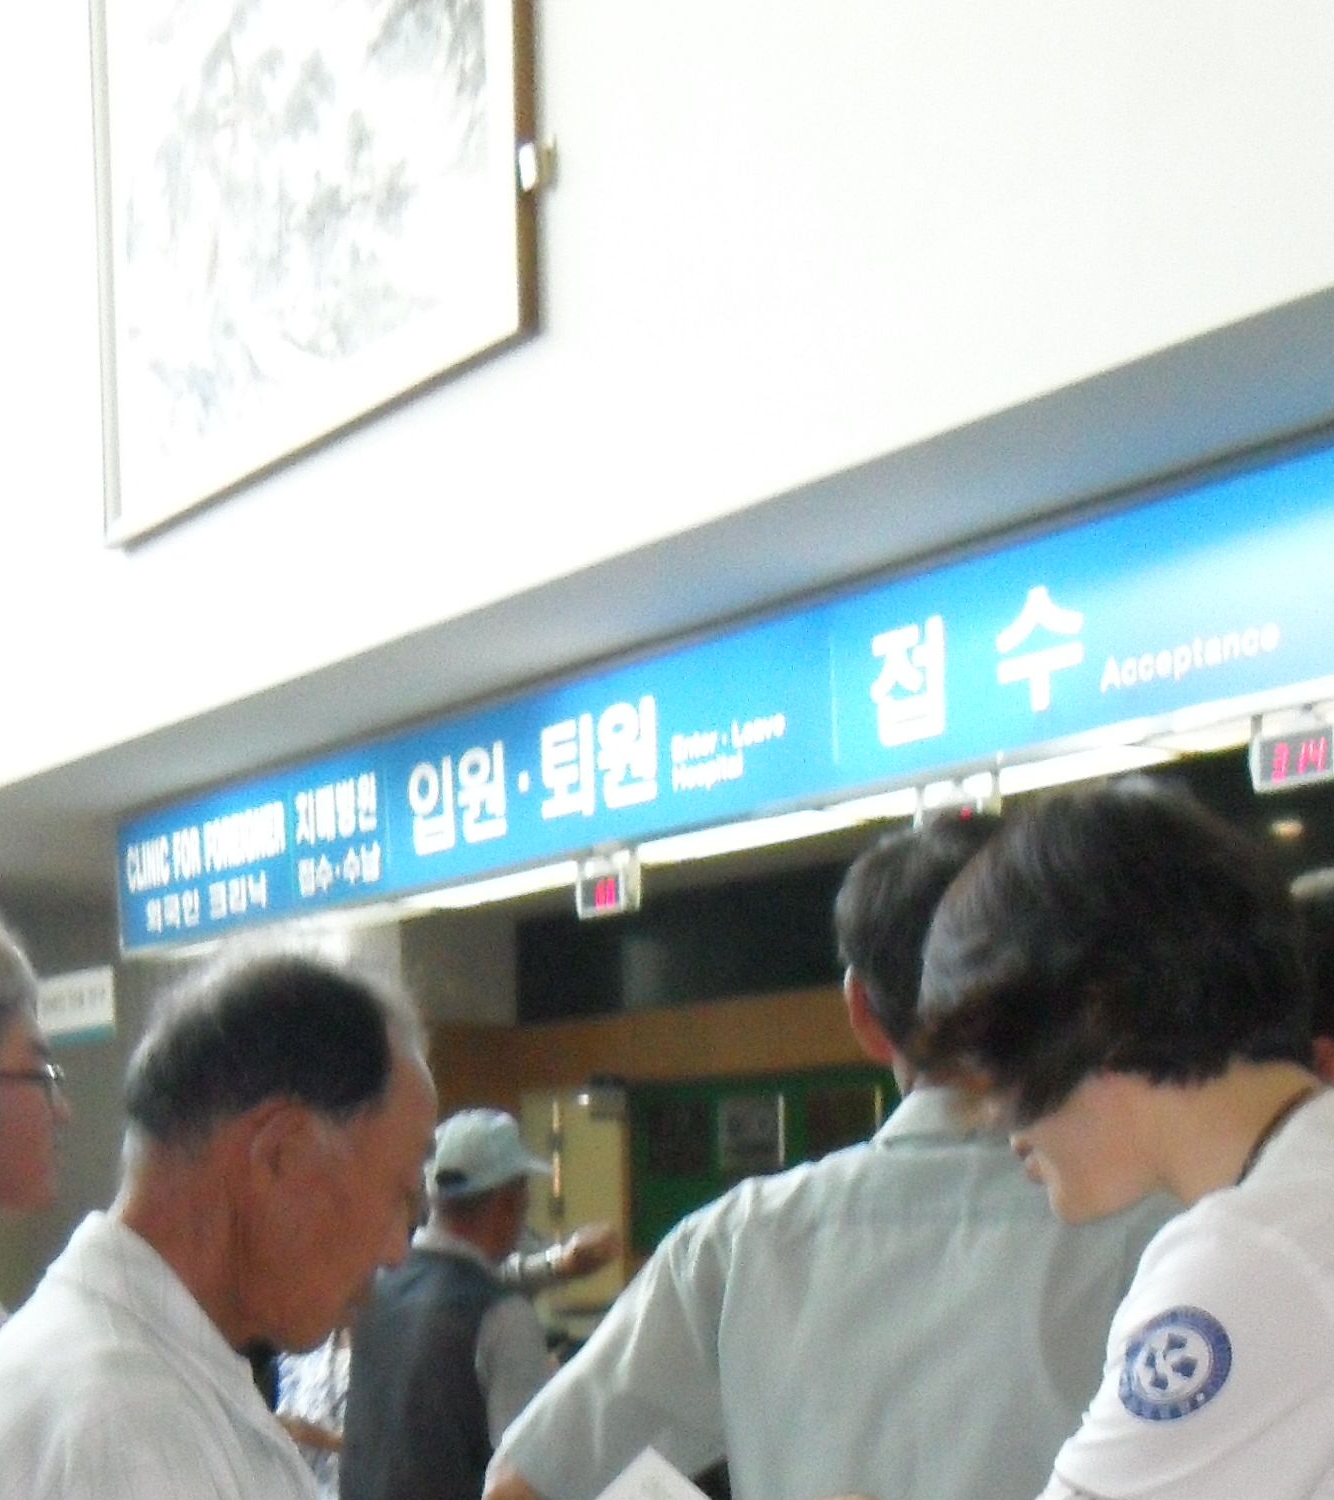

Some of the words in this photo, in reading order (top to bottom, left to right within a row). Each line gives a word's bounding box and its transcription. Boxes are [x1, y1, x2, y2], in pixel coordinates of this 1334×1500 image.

[1099, 622, 1280, 694] Acceptance
[125, 834, 170, 893] CLINIC
[171, 825, 203, 881] FOR
